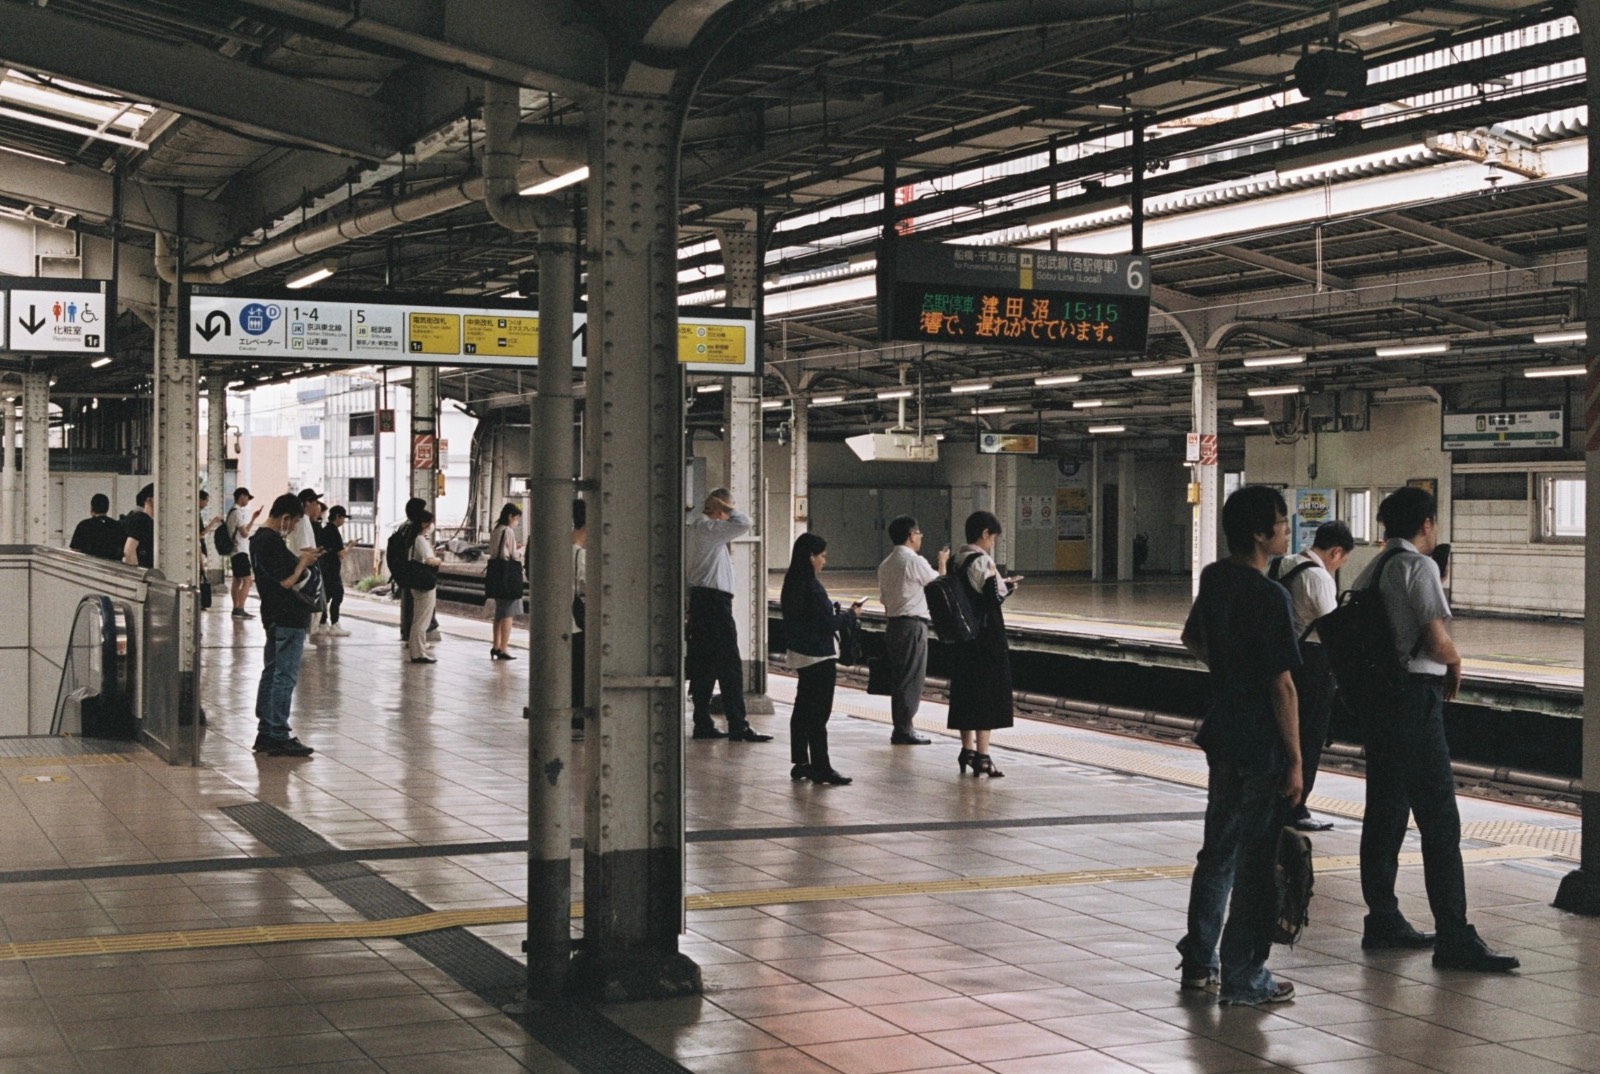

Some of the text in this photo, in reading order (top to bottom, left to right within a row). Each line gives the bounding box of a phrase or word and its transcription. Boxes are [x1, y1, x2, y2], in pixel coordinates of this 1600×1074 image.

[954, 249, 1017, 264] 船橋・千葉方面
[1023, 256, 1031, 264] JB
[1036, 254, 1118, 275] 総武線(各駅停車)
[1058, 272, 1075, 282] Line
[1127, 260, 1144, 290] 6
[268, 307, 277, 317] D
[922, 292, 974, 314] 各駅停車
[1063, 301, 1119, 322] 15:15
[356, 309, 366, 324] 5
[54, 325, 82, 336] 化粧室
[294, 325, 302, 333] JK
[307, 323, 342, 332] 京浜東北線
[87, 335, 99, 347] 1F
[239, 338, 280, 347] エレベーター
[307, 338, 328, 346] 山手線
